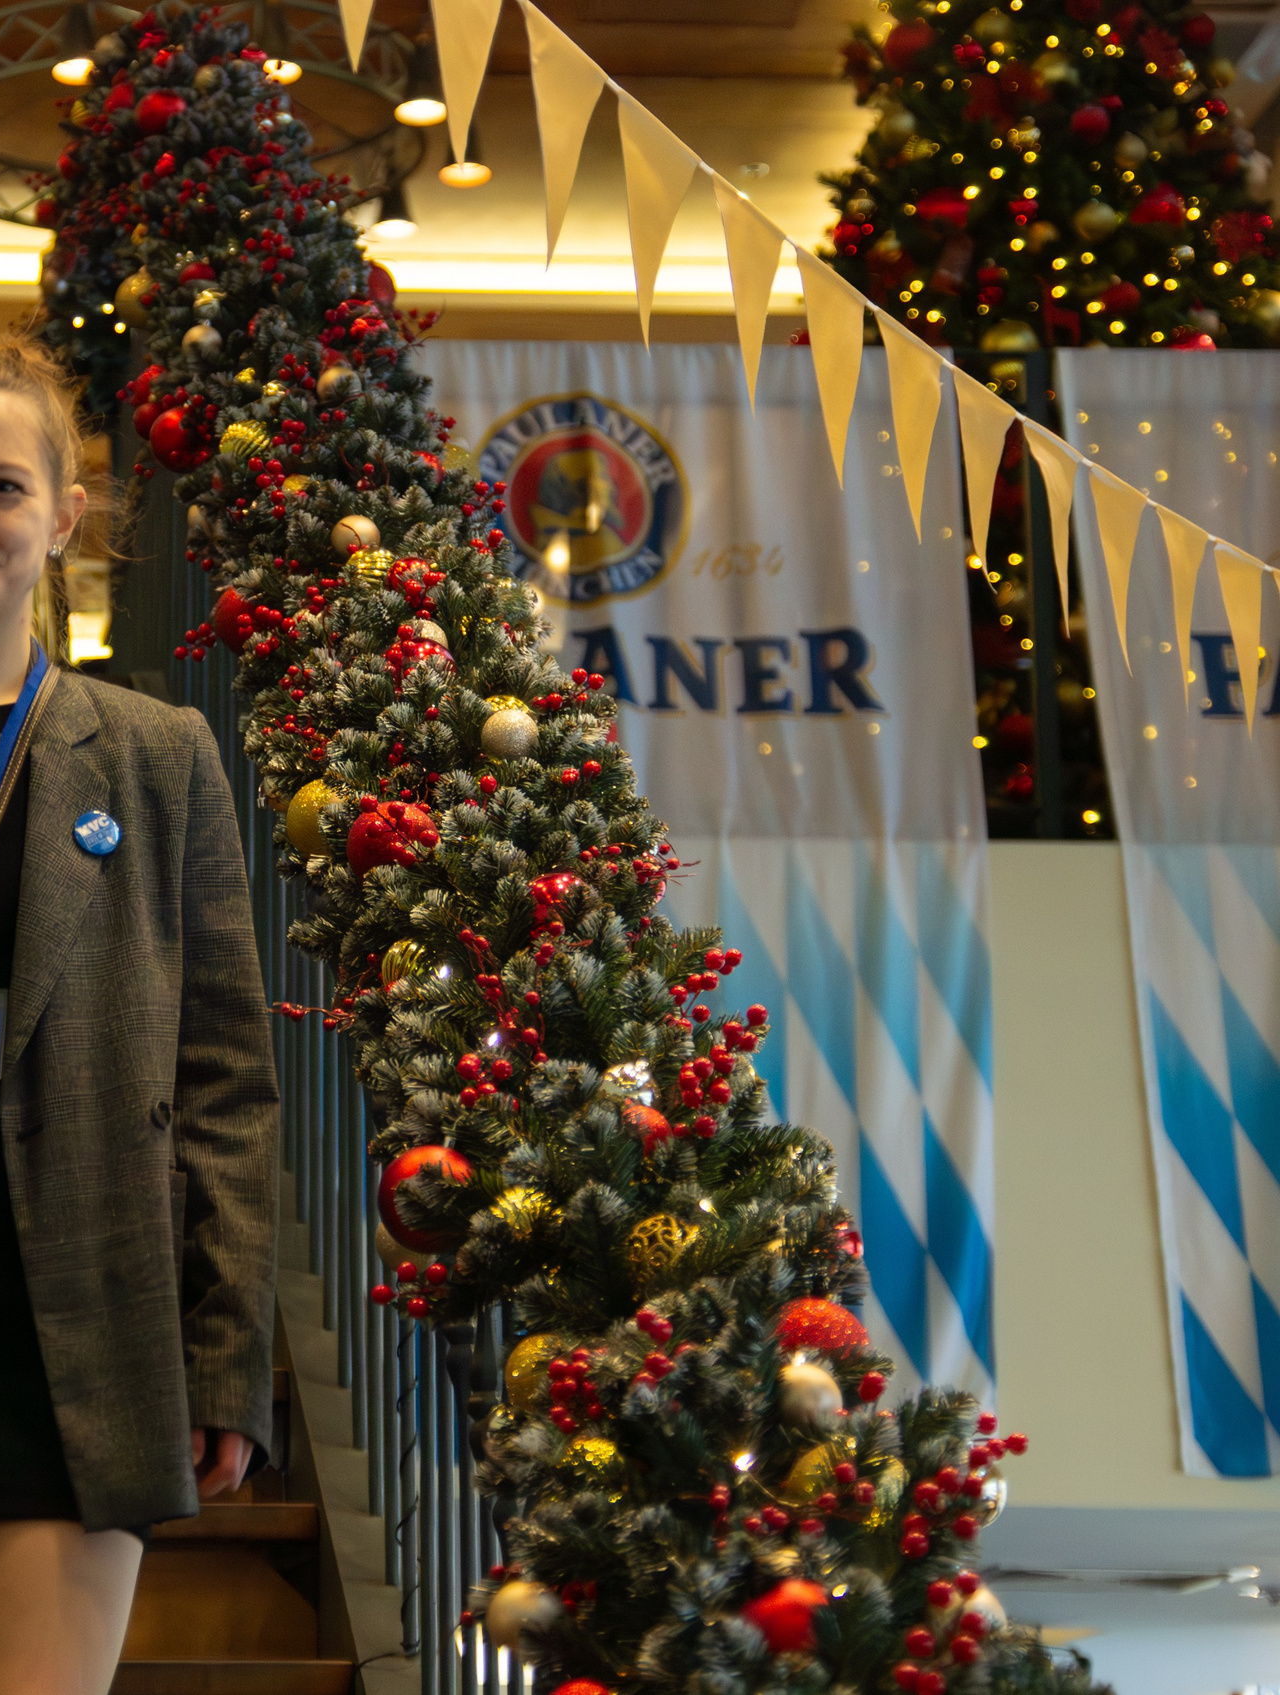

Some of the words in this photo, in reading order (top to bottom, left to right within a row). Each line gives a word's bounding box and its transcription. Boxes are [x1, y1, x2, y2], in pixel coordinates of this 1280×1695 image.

[479, 399, 676, 492] PAULANER
[692, 542, 785, 579] 1634
[572, 626, 888, 717] ANER
